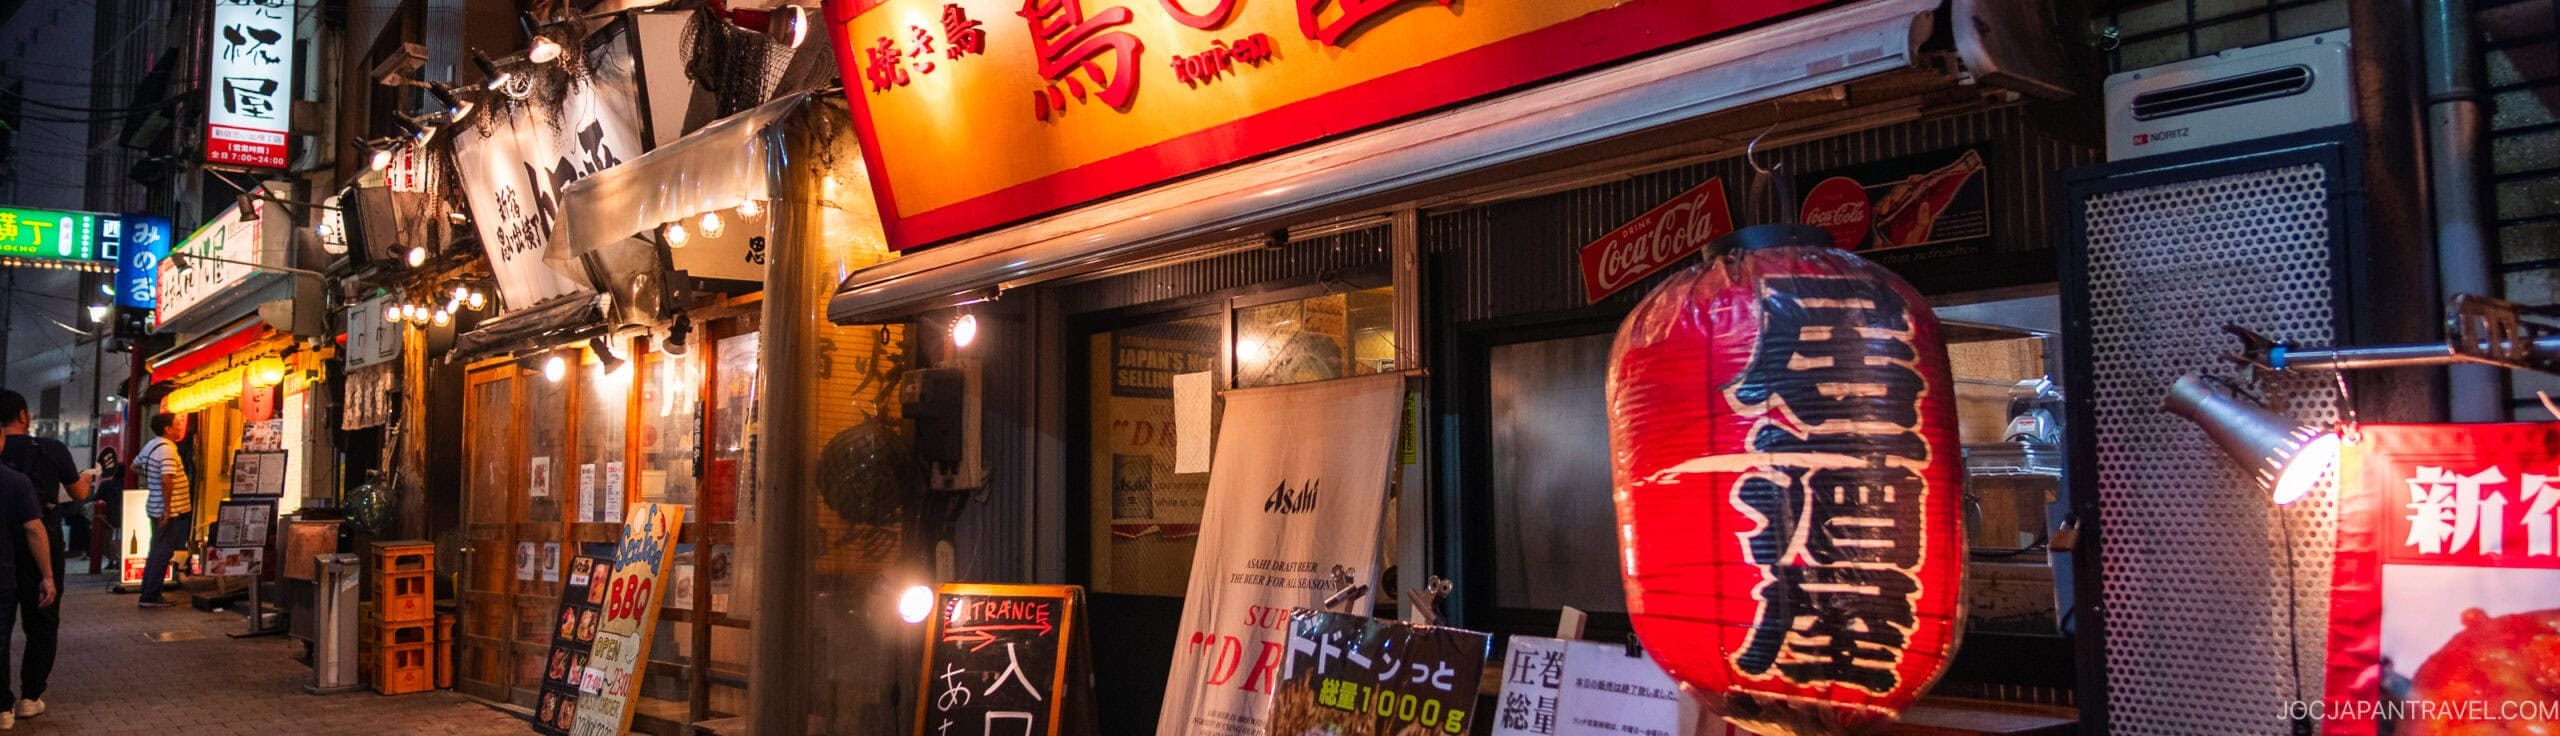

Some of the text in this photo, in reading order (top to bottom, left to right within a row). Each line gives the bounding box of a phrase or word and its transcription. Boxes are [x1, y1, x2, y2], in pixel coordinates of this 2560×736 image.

[866, 4, 986, 94] 焼き鳥
[1171, 33, 1272, 86] tori-en
[2151, 128, 2189, 143] NORITZ
[1623, 218, 1652, 238] DRINK
[1264, 477, 1320, 515] Asahi
[1722, 276, 1930, 694] 居酒屋
[614, 504, 670, 577] Seafood
[1231, 573, 1244, 585] THE
[1244, 574, 1265, 586] BEER
[1266, 574, 1285, 588] FOR
[1246, 559, 1269, 570] ASAHI
[1297, 561, 1318, 573] BEER
[608, 574, 651, 627] BBQ
[944, 598, 1050, 624] TRANCE
[1243, 604, 1289, 631] SUP
[595, 636, 622, 662] OPEN
[1508, 649, 1565, 690] 圧巻
[1318, 677, 1466, 734] 総量1000g
[1501, 690, 1558, 736] 総量
